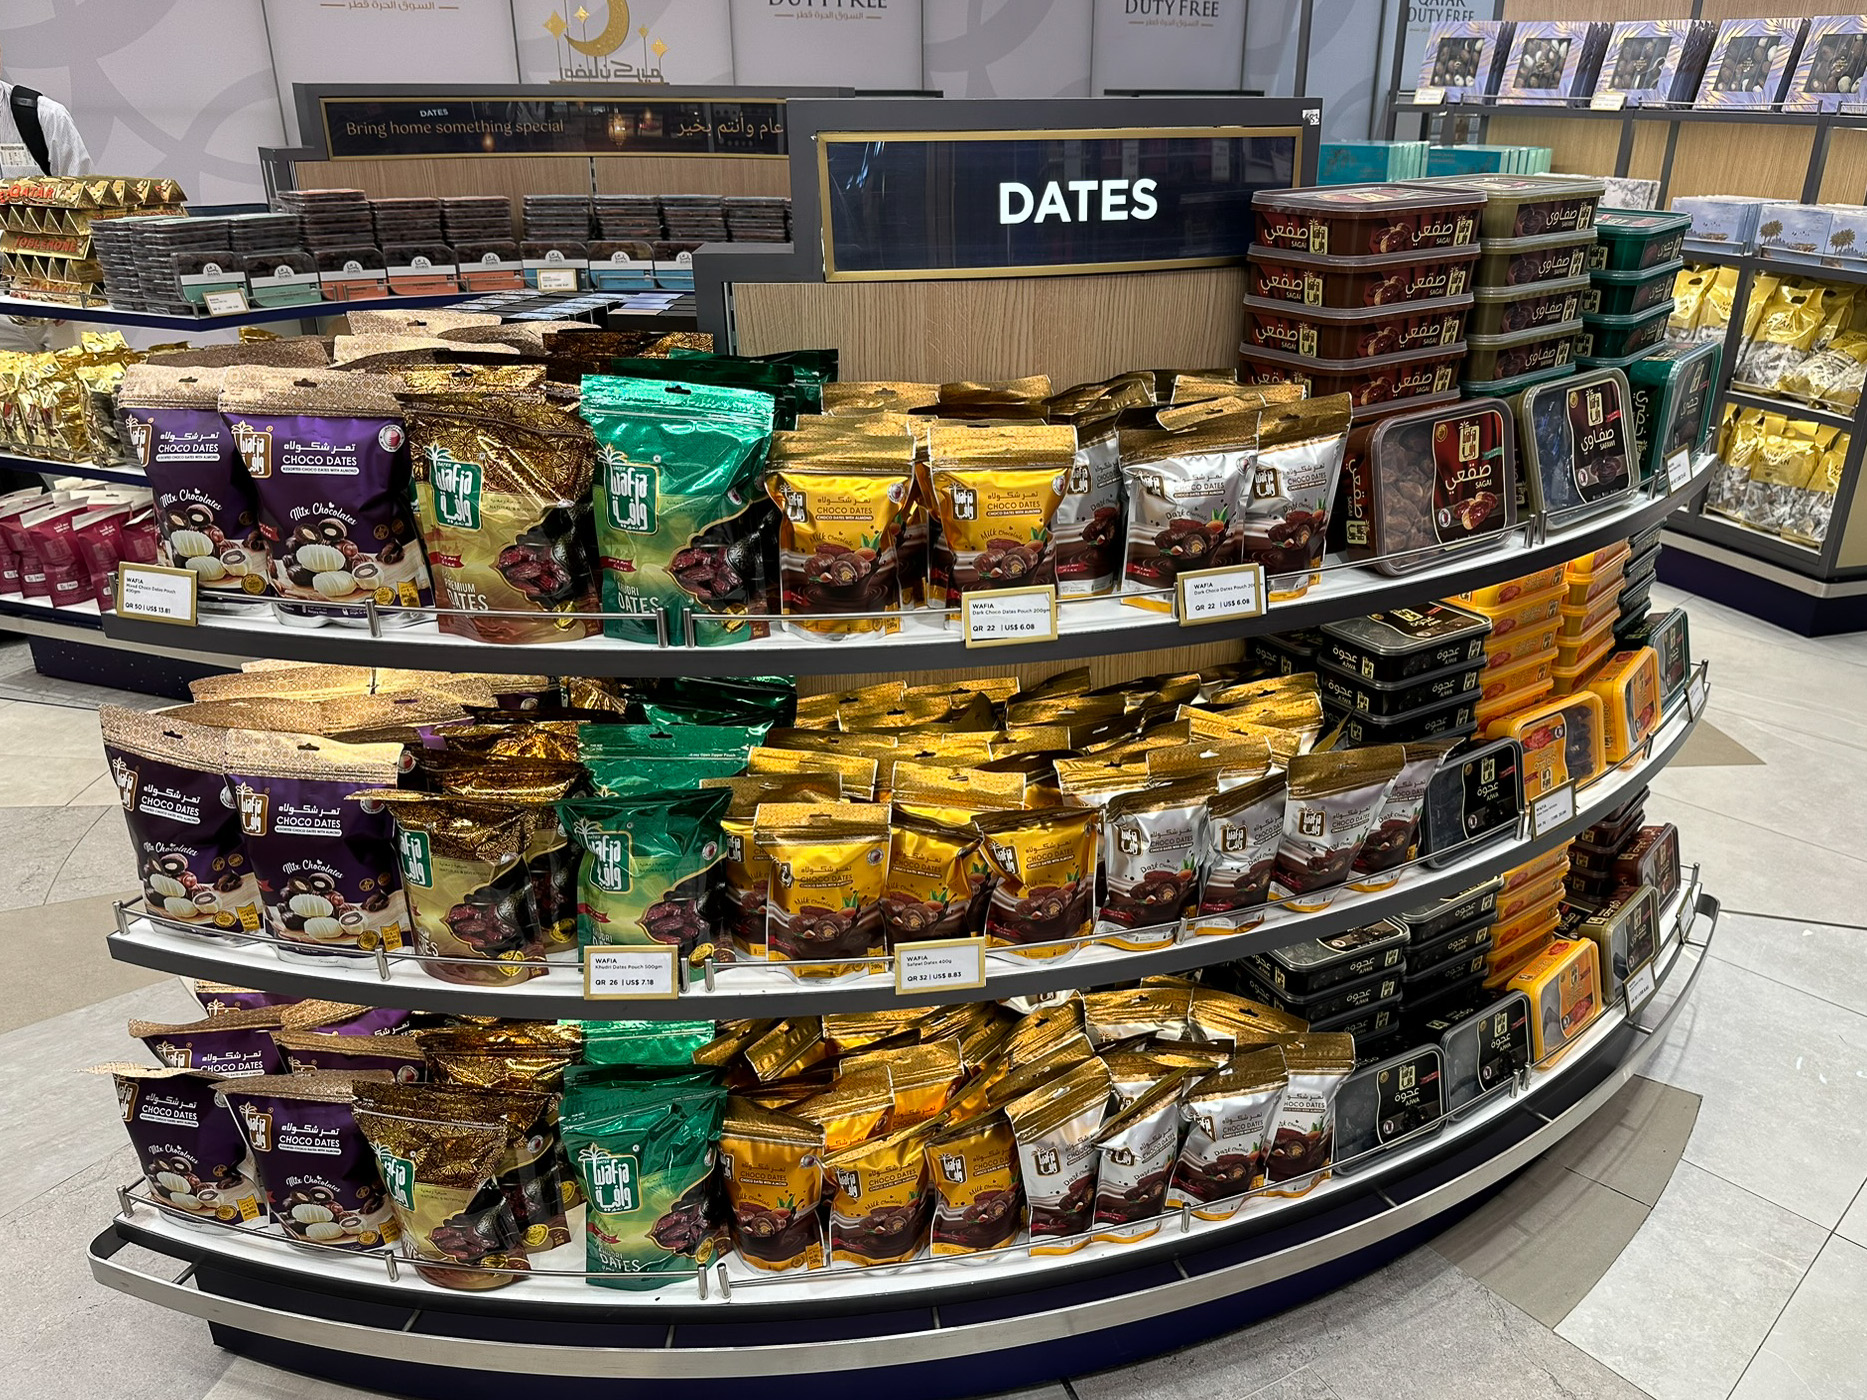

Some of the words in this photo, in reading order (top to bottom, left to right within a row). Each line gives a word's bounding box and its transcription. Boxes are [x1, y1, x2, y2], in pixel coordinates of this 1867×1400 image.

[1125, 0, 1175, 16] DUTY
[1179, 0, 1221, 18] FREE
[1409, 7, 1443, 23] DUTY
[419, 108, 449, 118] DATES
[346, 122, 388, 139] Bring
[389, 121, 432, 134] home
[435, 120, 513, 137] something
[515, 119, 565, 137] special
[677, 115, 713, 137] بخير
[716, 112, 755, 139] وأنتم
[759, 117, 784, 140] عام
[11, 185, 55, 200] QATAR
[999, 177, 1158, 224] DATES
[16, 236, 77, 253] TOBLERONE
[159, 431, 198, 443] شكولاه
[197, 432, 220, 442] تمر
[1580, 426, 1615, 455] صفاوي
[158, 443, 191, 453] CHOCO
[192, 444, 219, 453] DATES
[283, 441, 331, 453] شكولاه
[331, 443, 356, 454] تمر
[1599, 440, 1616, 451] SAFAWI
[282, 455, 324, 465] CHOCO
[326, 456, 358, 466] DATES
[1288, 476, 1309, 486] CHOCO
[1309, 473, 1327, 482] DATES
[1445, 463, 1492, 495] صقعي
[1475, 479, 1493, 490] SAGAI
[1174, 483, 1202, 492] CHOCO
[1202, 482, 1225, 490] DATES
[1346, 459, 1365, 519] صقعي
[160, 494, 178, 508] Mix
[179, 489, 223, 512] Chocolates
[986, 501, 1015, 511] CHOCO
[1016, 500, 1041, 510] DATES
[289, 506, 310, 521] Mix
[312, 501, 358, 526] Chocolates
[816, 507, 848, 515] CHOCO
[849, 507, 873, 515] DATES
[1165, 509, 1186, 521] Dark
[980, 527, 998, 542] Milk
[126, 577, 144, 585] WAFIA
[1193, 582, 1214, 590] WAFIA
[125, 601, 135, 610] QR
[146, 605, 158, 613] US$
[447, 588, 490, 612] DATES
[618, 591, 659, 614] DATES
[1223, 601, 1236, 609] US$
[1004, 624, 1018, 632] US$
[1020, 623, 1036, 631] 6.08
[1332, 643, 1358, 664] عجوة
[1328, 678, 1353, 699] عجوة
[1476, 781, 1499, 797] عجوة
[141, 796, 175, 811] CHOCO
[175, 801, 200, 817] DATES
[319, 806, 341, 816] تمر
[276, 816, 312, 827] CHOCO
[314, 818, 341, 828] DATES
[1332, 818, 1354, 828] CHOCO
[1377, 813, 1394, 824] Dark
[1150, 837, 1173, 847] CHOCO
[1173, 834, 1194, 845] DATES
[1254, 827, 1273, 841] CHOCO
[1026, 853, 1053, 864] CHOCO
[1053, 848, 1074, 859] DATES
[282, 861, 301, 875] Mix
[302, 858, 344, 880] Chocolates
[893, 859, 920, 870] CHOCO
[920, 863, 943, 873] DATES
[1140, 862, 1158, 875] Dark
[800, 875, 829, 883] CHOCO
[830, 874, 854, 882] DATES
[1350, 957, 1377, 973] عجوة
[595, 979, 606, 987] QR
[625, 979, 640, 987] US$
[907, 975, 918, 983] QR
[932, 973, 946, 981] US$
[947, 971, 962, 979] 8.83
[1346, 989, 1371, 1004] عجوة
[1490, 1033, 1512, 1049] عجوة
[242, 1050, 262, 1061] تمر
[200, 1062, 235, 1073] CHOCO
[236, 1061, 263, 1071] DATES
[1394, 1086, 1421, 1103] عجوة
[1405, 1096, 1421, 1106] AJWA
[1304, 1100, 1326, 1109] DATES
[141, 1105, 173, 1118] CHOCO
[173, 1109, 198, 1121] DATES
[318, 1126, 340, 1136] تمر
[1222, 1124, 1245, 1134] CHOCO
[1245, 1119, 1265, 1130] DATES
[278, 1134, 312, 1147] CHOCO
[314, 1137, 341, 1149] DATES
[165, 1143, 199, 1165] Chocolates
[1213, 1147, 1230, 1158] Dark
[973, 1158, 999, 1172] CHOCO
[740, 1170, 764, 1180] CHOCO
[764, 1171, 788, 1182] DATES
[868, 1175, 894, 1187] CHOCO
[894, 1169, 918, 1181] DATES
[1133, 1169, 1150, 1182] Dark
[304, 1174, 343, 1194] Chocolates
[969, 1184, 985, 1198] Milk
[600, 1253, 641, 1273] DATES
